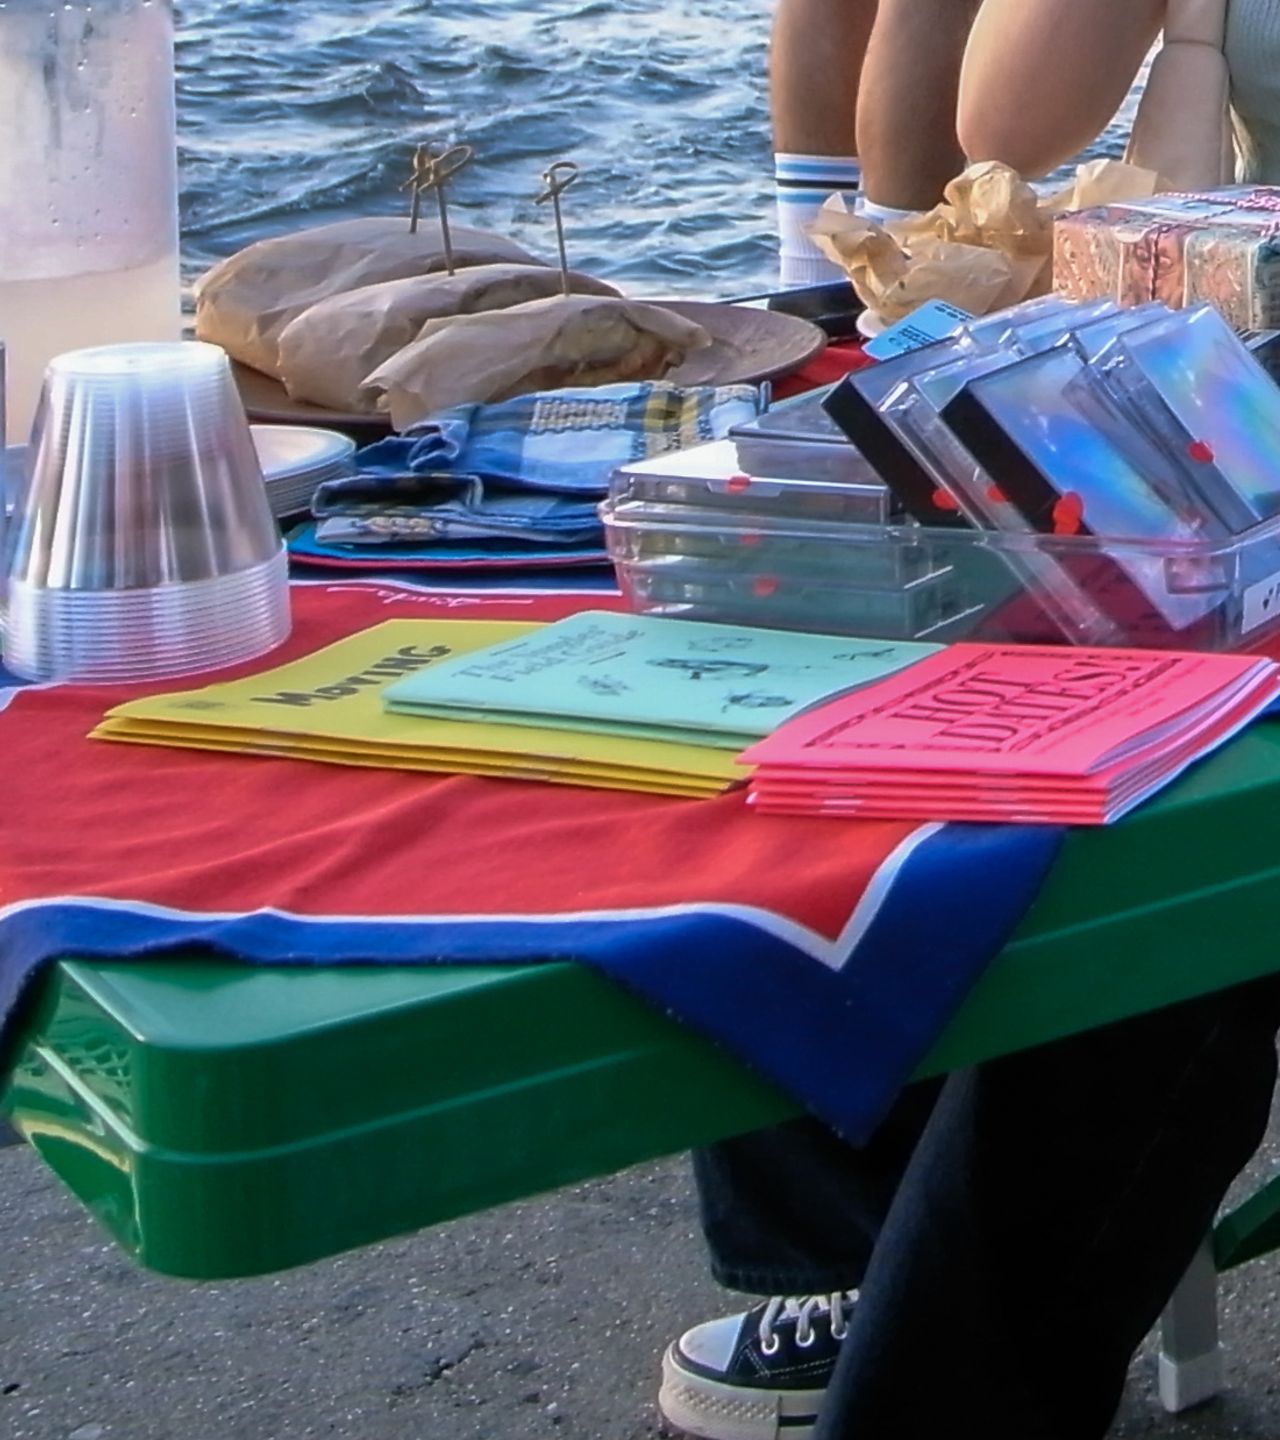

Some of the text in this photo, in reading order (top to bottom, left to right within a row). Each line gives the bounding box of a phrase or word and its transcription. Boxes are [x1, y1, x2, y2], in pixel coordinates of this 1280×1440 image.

[249, 645, 452, 707] MOVING
[887, 671, 1032, 724] HOT
[932, 661, 1142, 743] DATES!
